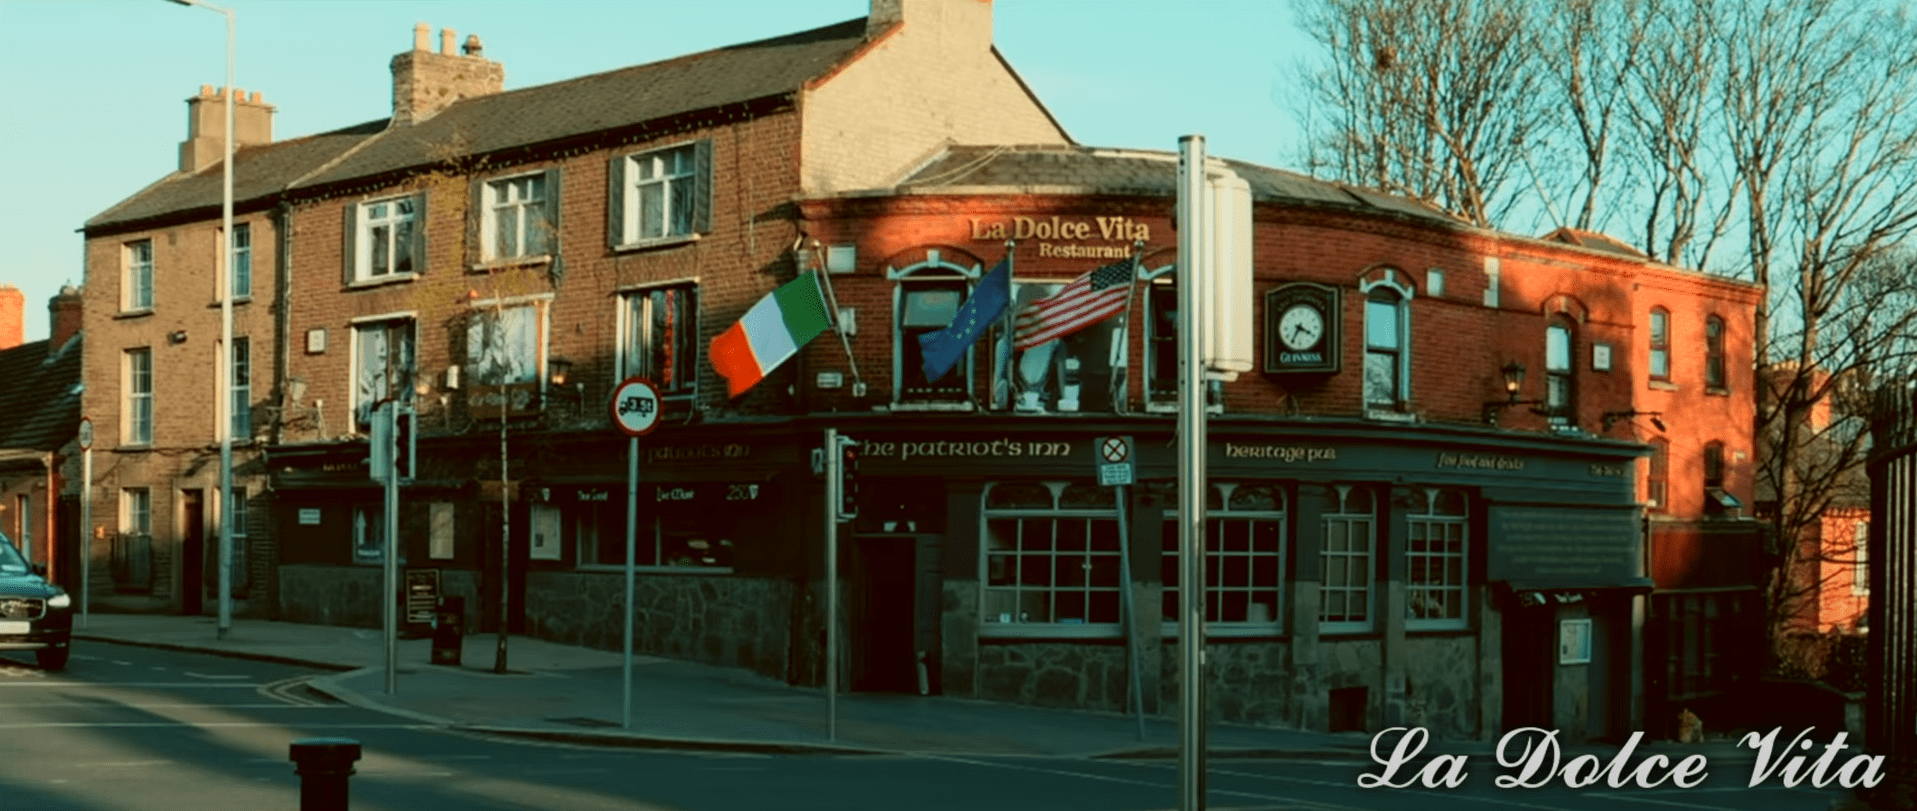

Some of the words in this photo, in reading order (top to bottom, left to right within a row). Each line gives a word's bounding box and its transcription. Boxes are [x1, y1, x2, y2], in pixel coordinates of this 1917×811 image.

[970, 217, 1006, 239] La
[1014, 215, 1090, 240] Dolce
[1096, 216, 1150, 241] Vita
[1039, 242, 1131, 259] Restaurant
